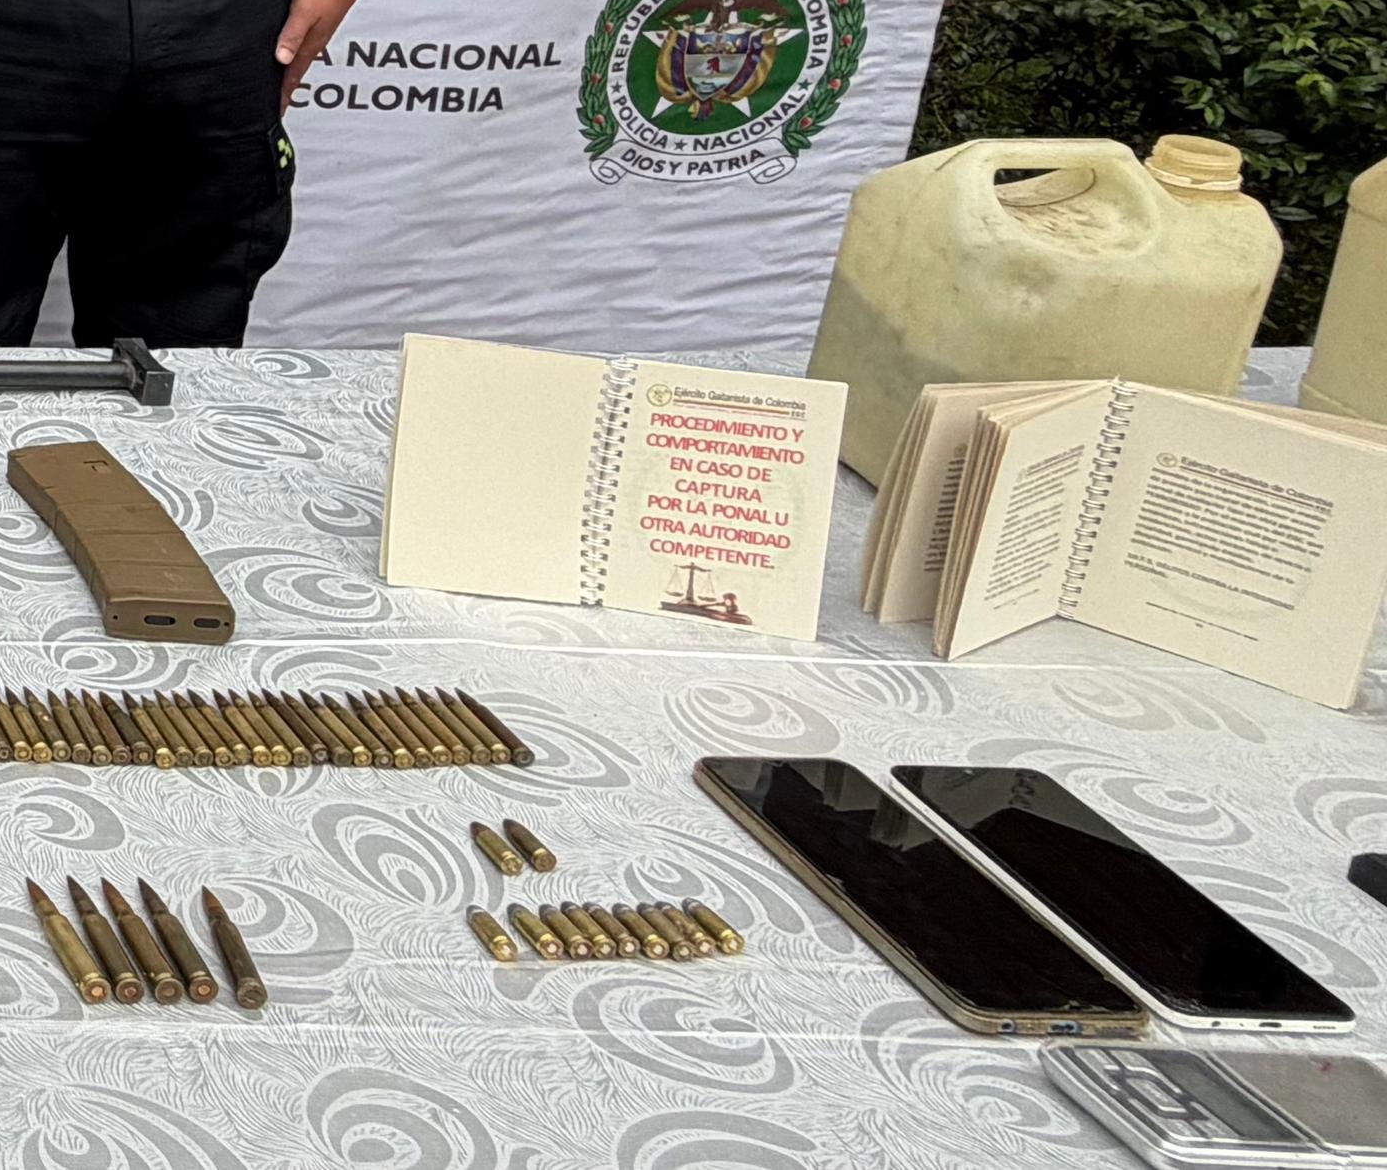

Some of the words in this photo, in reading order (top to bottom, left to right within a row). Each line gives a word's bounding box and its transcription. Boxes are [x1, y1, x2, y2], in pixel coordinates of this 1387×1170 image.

[347, 41, 561, 70] NACIONAL
[290, 82, 504, 112] COLOMBIA
[693, 93, 806, 151] NACIONAL
[620, 149, 666, 175] DIOS
[667, 161, 682, 175] Y
[687, 149, 765, 175] PATRIA
[753, 395, 763, 405] de
[766, 397, 806, 410] Colombia
[650, 413, 787, 441] PROCEDIMIENTO
[792, 429, 804, 443] Y
[646, 433, 805, 464] COMPORTAMIENTO
[670, 457, 693, 472] EN
[697, 460, 742, 478] CASO
[747, 467, 772, 482] DE
[675, 479, 762, 503] CAPTURA
[647, 495, 683, 512] POR
[686, 500, 708, 515] LA
[712, 504, 772, 524] PONAL
[775, 512, 789, 526] U
[640, 516, 686, 534] OTRA
[688, 523, 791, 549] AUTORIDAD
[650, 539, 775, 570] COMPETENTE.
